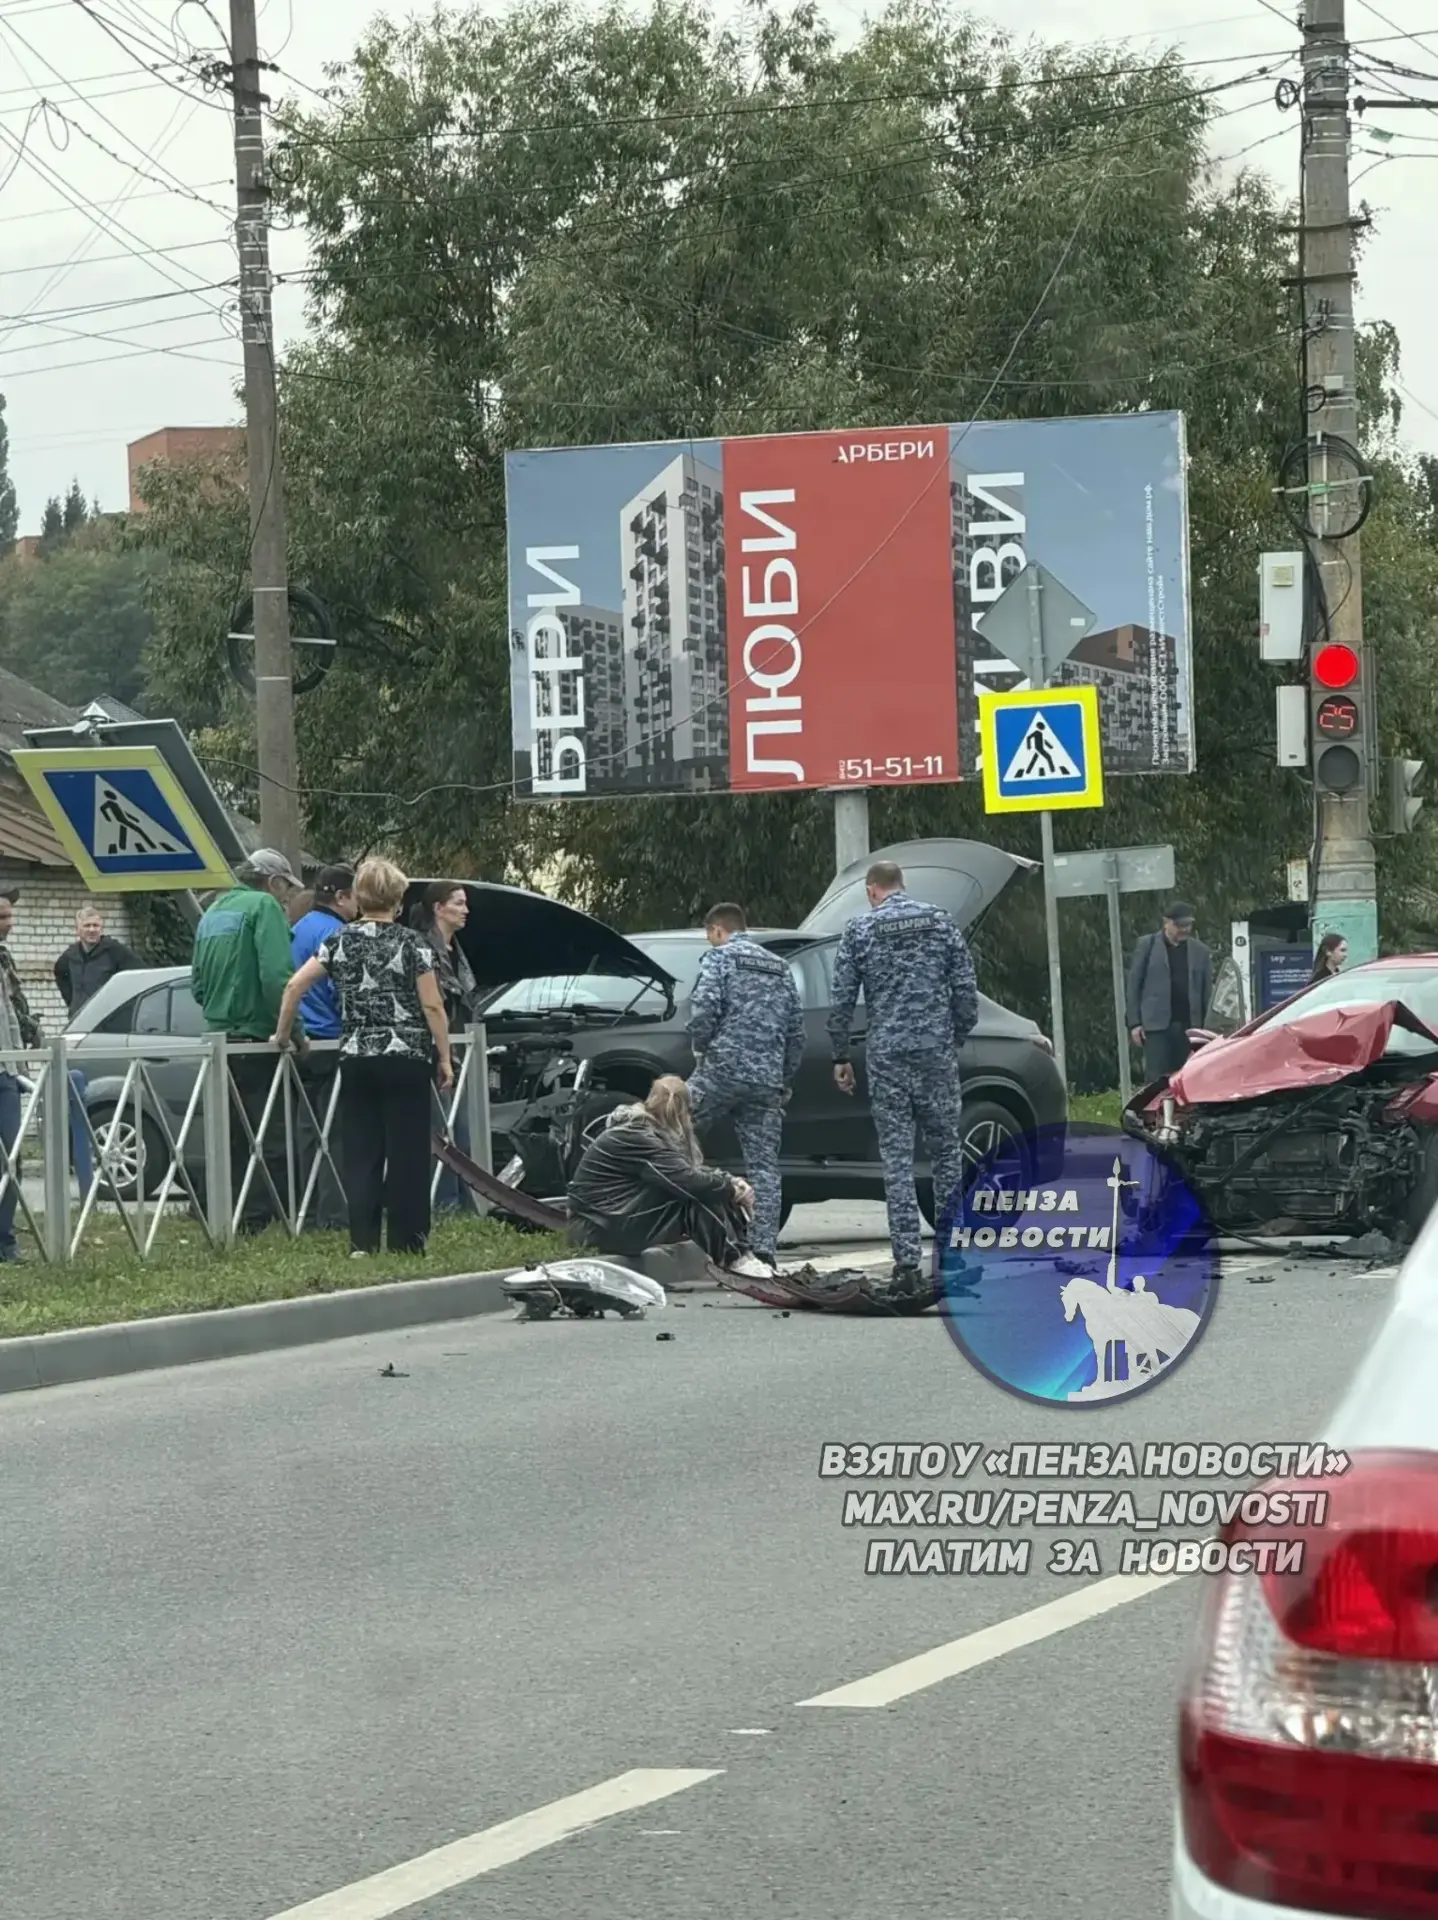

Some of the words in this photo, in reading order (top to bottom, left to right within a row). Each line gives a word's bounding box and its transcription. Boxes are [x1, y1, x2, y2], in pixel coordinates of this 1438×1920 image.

[525, 545, 586, 793] БЕРИ
[740, 488, 804, 782] ЛЮБИ
[846, 755, 943, 779] 51-51-11
[1319, 703, 1355, 730] 25
